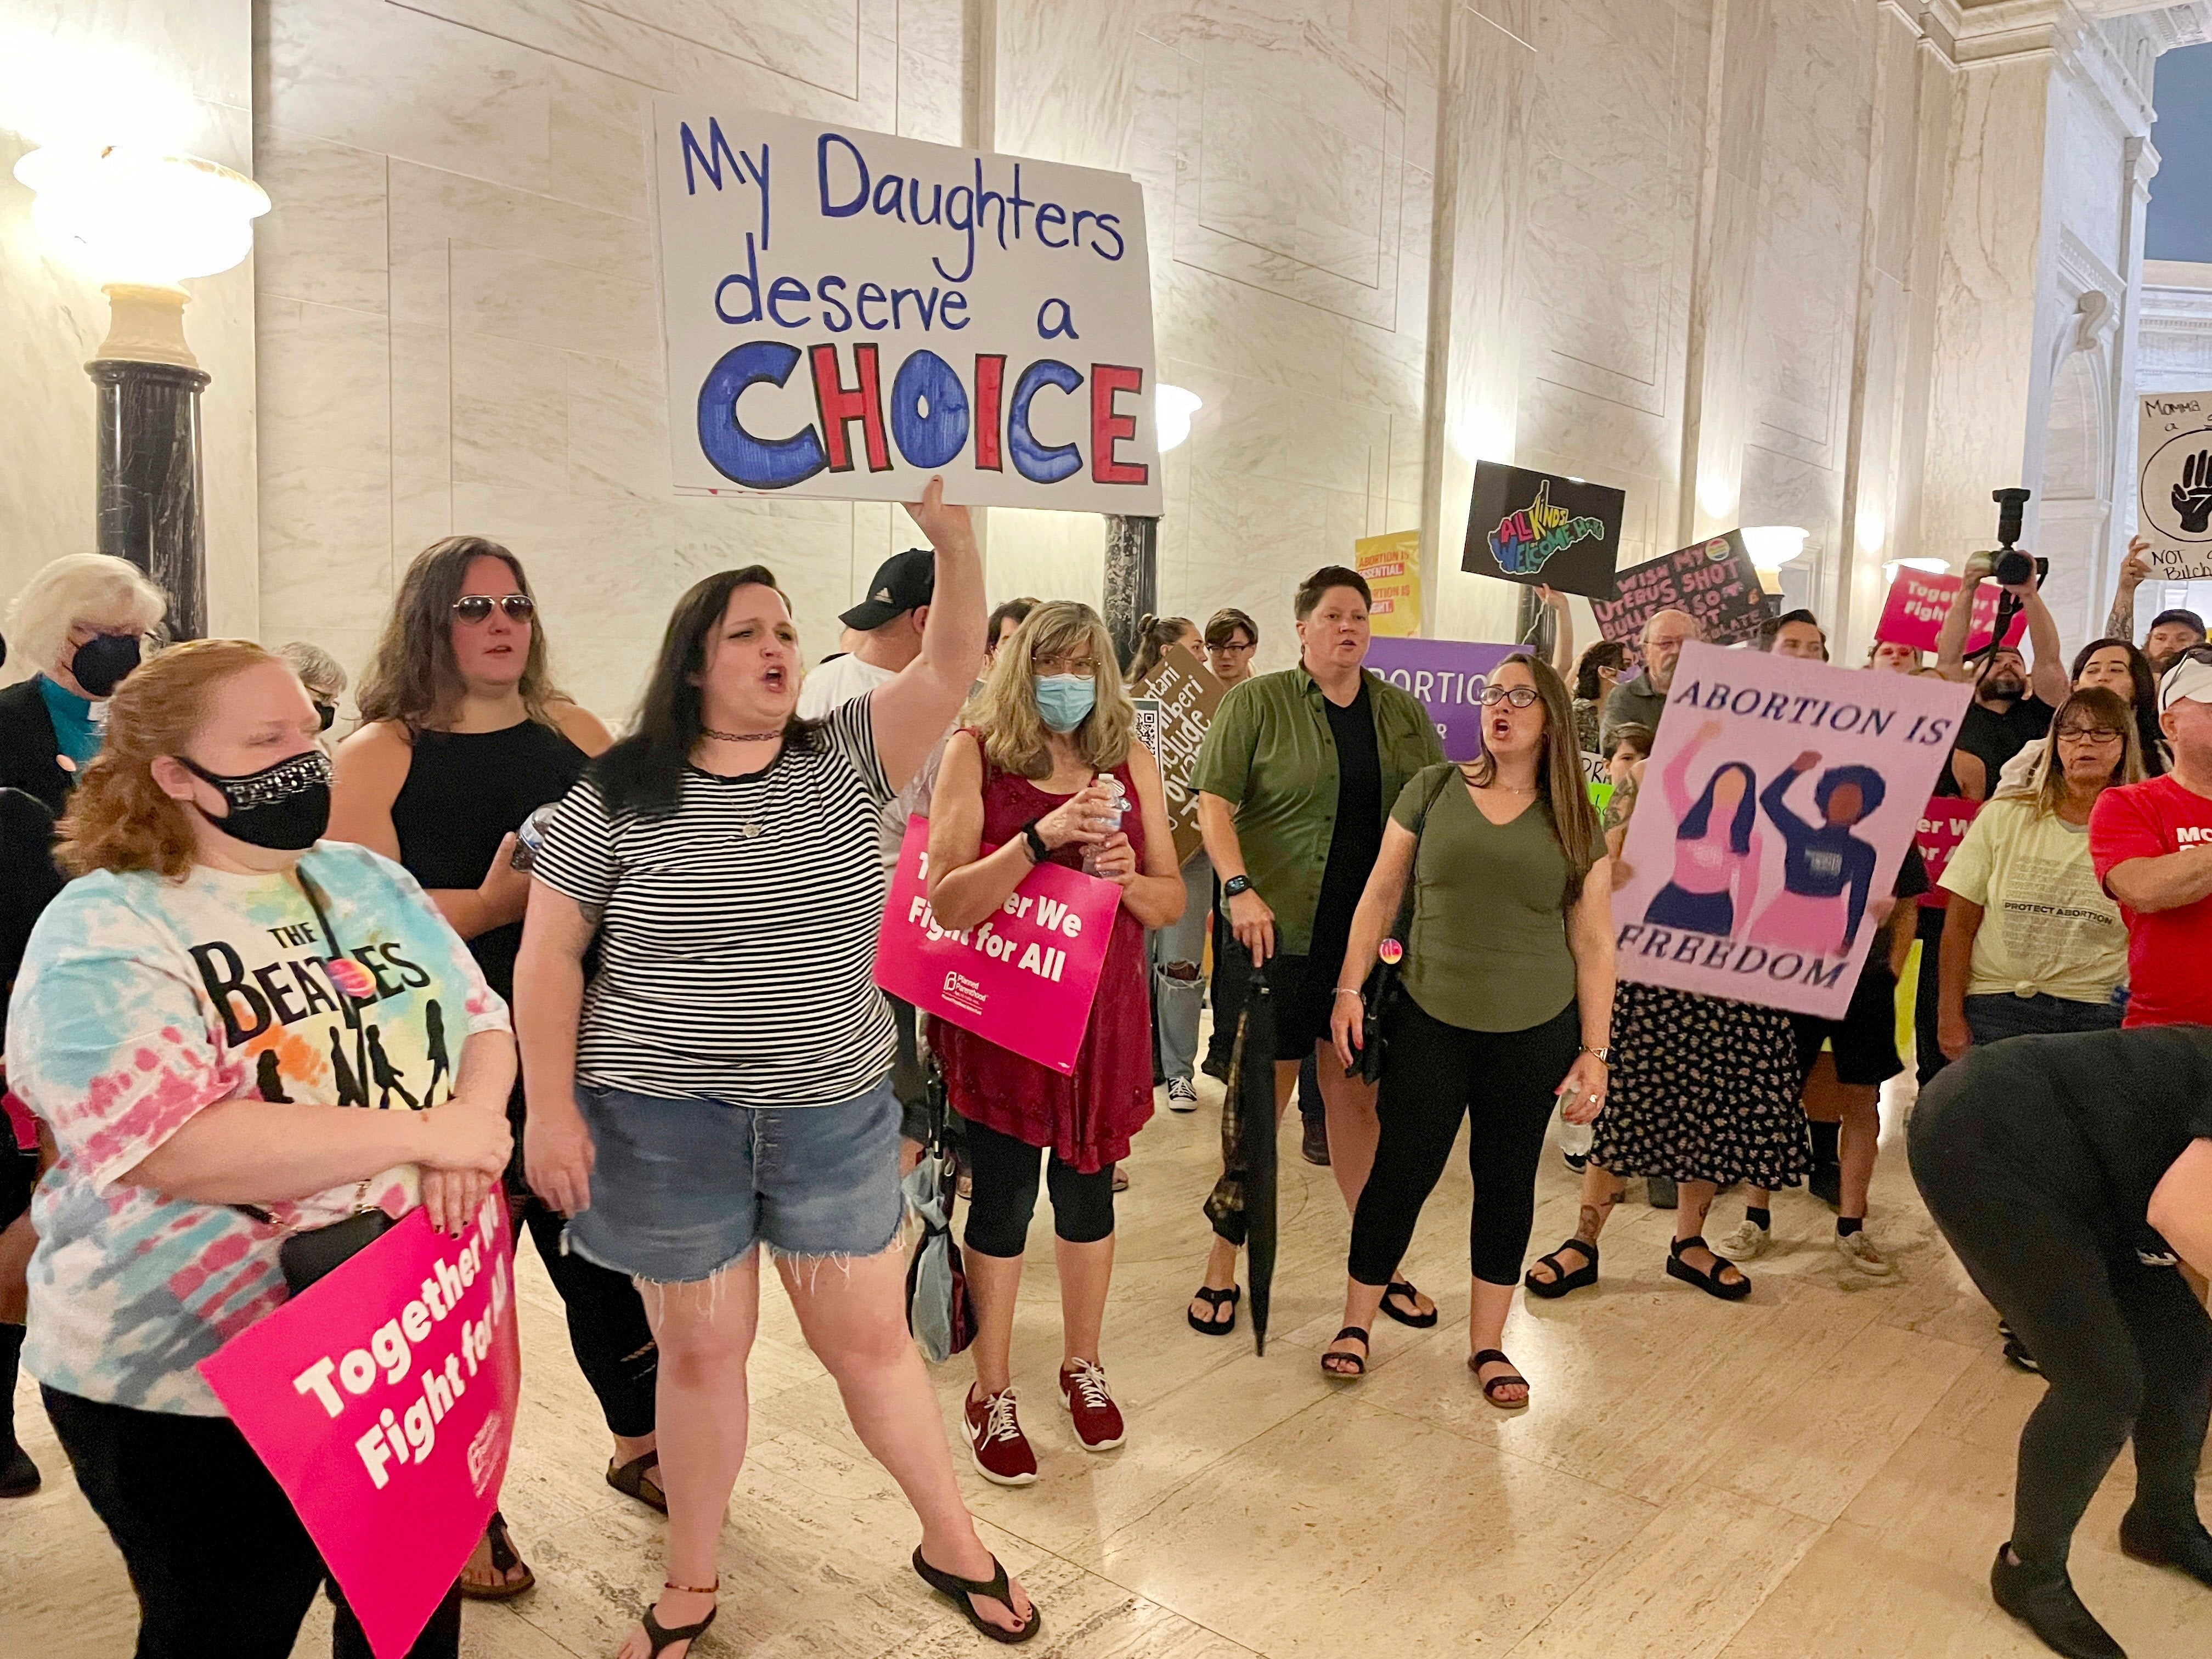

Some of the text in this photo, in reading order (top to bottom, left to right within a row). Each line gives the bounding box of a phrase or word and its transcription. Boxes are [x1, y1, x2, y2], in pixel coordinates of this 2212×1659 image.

[681, 117, 1124, 282] My Daughters
[715, 233, 1079, 340] deserve a
[697, 341, 1148, 488] CHOICE
[1491, 524, 1574, 572] WELCOME
[1501, 510, 1533, 543] ALL
[1681, 557, 1740, 592] SHOT
[2152, 549, 2186, 566] NOT
[1673, 679, 1953, 745] ABORTION IS
[266, 922, 318, 948] THE
[1036, 895, 1082, 938] We
[2005, 902, 2113, 925] PROTECT ABORTION
[975, 922, 1018, 962] for
[1018, 943, 1066, 982] All
[1616, 922, 1849, 989] FREEDOM
[293, 1233, 481, 1418] Together
[355, 1351, 465, 1490] Fight
